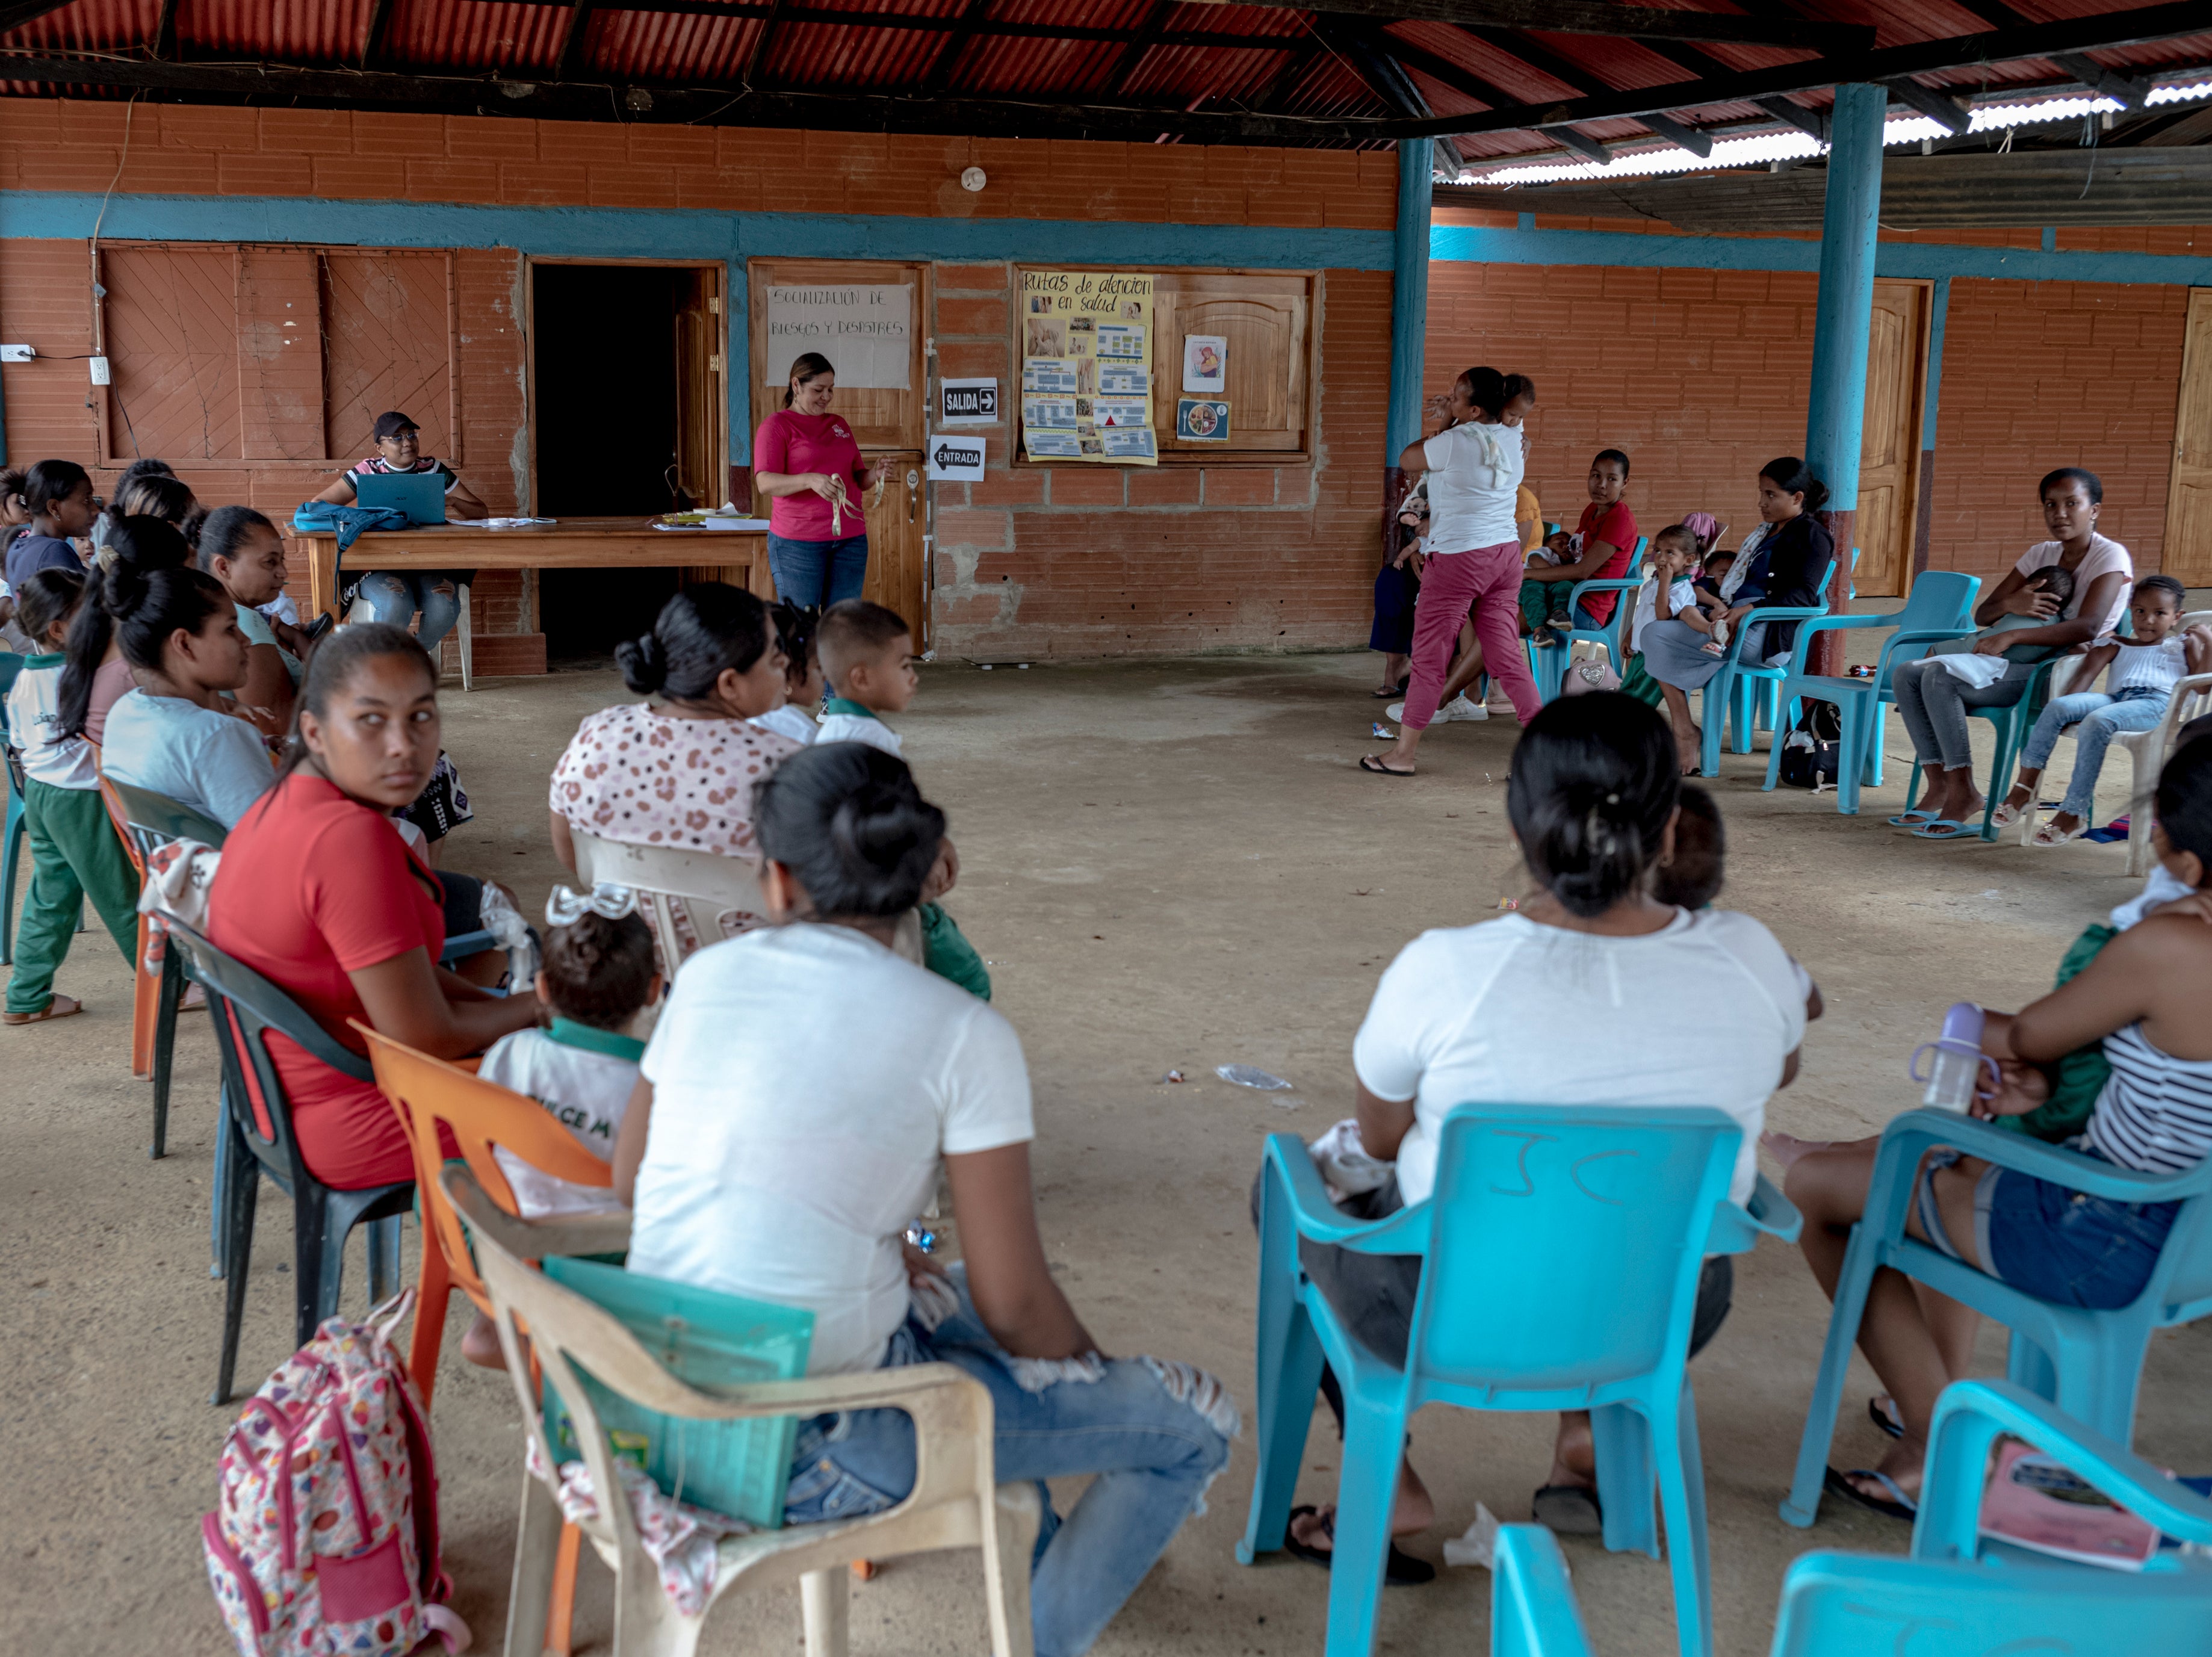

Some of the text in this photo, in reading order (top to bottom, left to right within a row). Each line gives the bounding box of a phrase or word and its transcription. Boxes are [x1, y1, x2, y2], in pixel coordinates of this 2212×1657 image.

[1024, 273, 1068, 292] Rutas
[1075, 274, 1092, 294] de
[774, 288, 887, 305] SOCIALIZACIÓN DE
[1058, 294, 1117, 312] en salud
[771, 320, 903, 338] RIESGOS Y DESASTRES
[946, 393, 978, 411] SALIDA
[938, 451, 979, 464] ENTRADA
